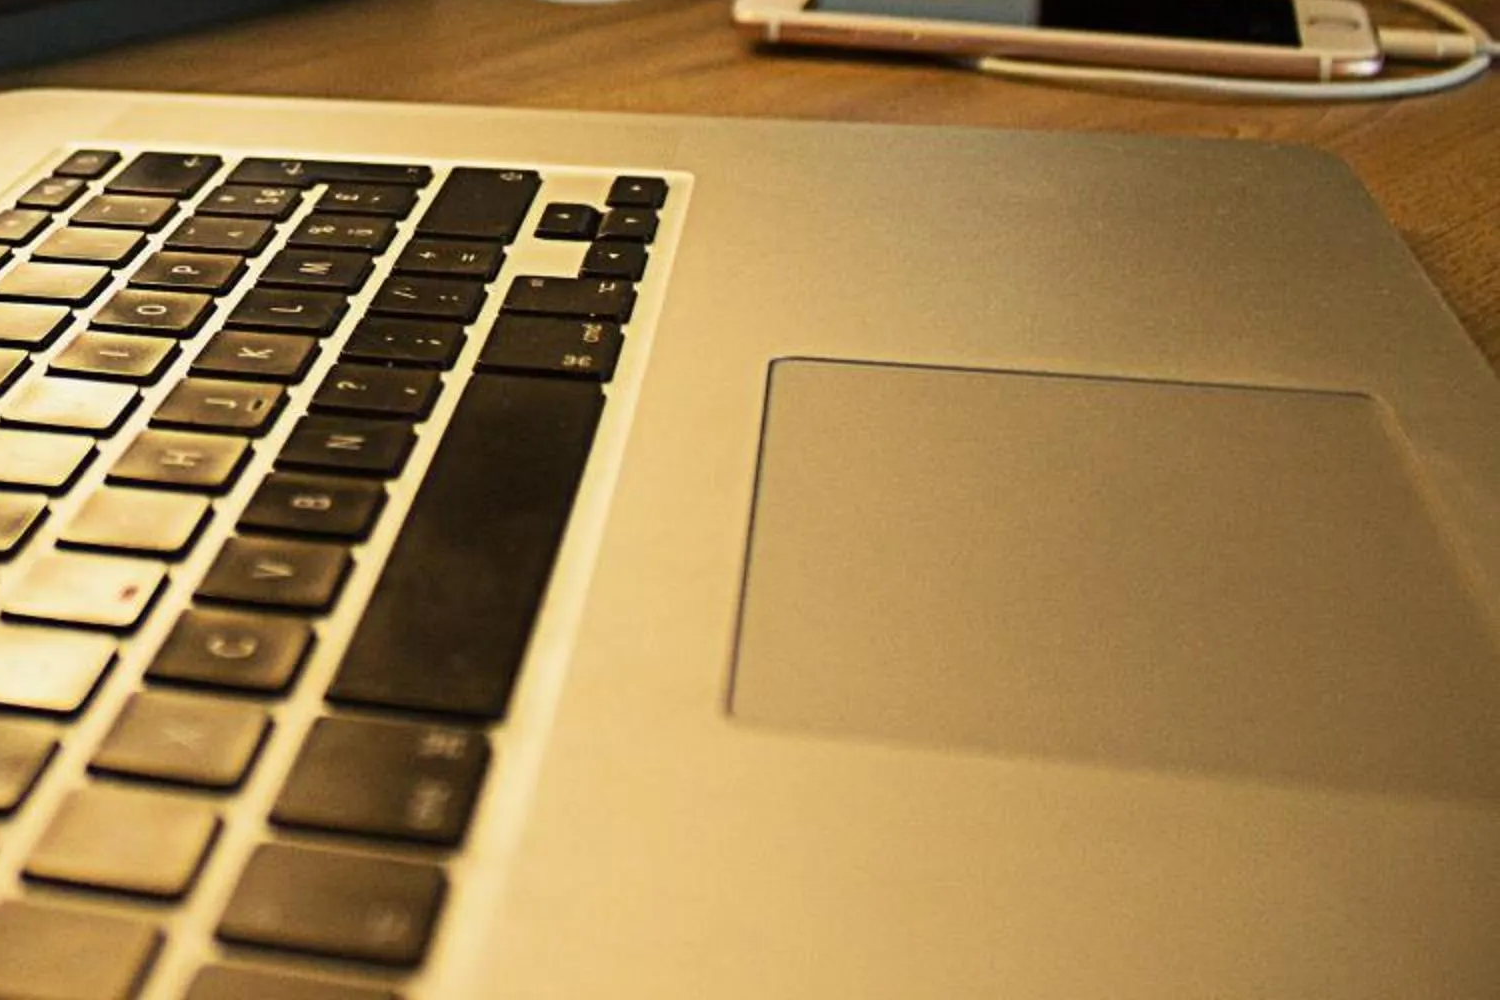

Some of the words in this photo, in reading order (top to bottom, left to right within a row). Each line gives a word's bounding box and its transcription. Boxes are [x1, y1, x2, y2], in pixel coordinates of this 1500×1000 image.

[170, 264, 202, 276] P
[298, 261, 334, 277] M
[135, 304, 168, 316] O
[270, 303, 305, 315] L
[237, 347, 275, 361] K
[204, 396, 239, 411] J
[325, 434, 365, 452] N
[160, 448, 202, 469] H
[290, 495, 333, 512] B
[252, 561, 295, 581] V
[205, 633, 259, 660] C
